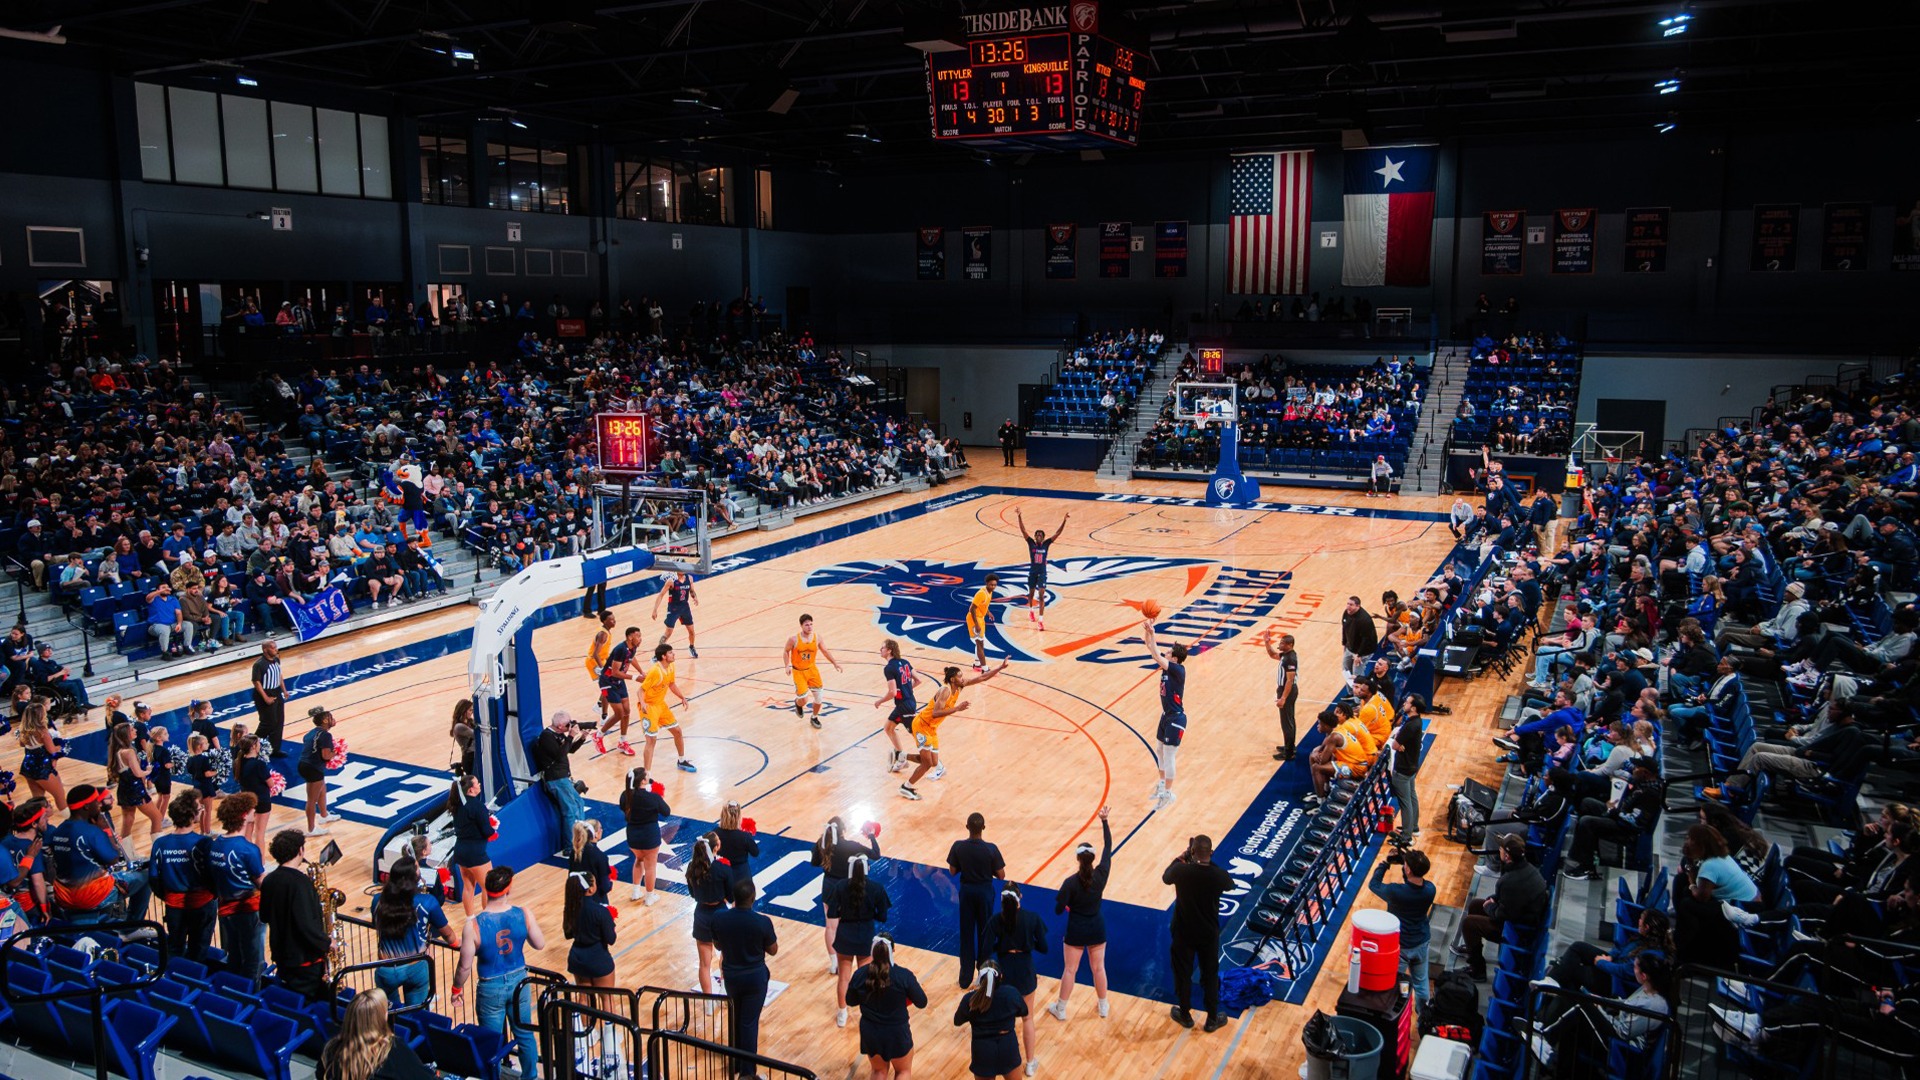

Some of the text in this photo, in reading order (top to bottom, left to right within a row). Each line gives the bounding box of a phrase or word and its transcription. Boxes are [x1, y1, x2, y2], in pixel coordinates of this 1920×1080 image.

[981, 41, 1024, 63] 13:26
[1024, 61, 1069, 74] KINGSVILLE
[990, 71, 1010, 79] PERIOD
[1001, 82, 1006, 95] 1
[1046, 74, 1063, 94] 13
[1074, 35, 1091, 130] PATRIOTS
[953, 81, 969, 101] 13
[983, 100, 1003, 108] PLAYER
[1047, 96, 1065, 104] FOULS
[953, 104, 1064, 125] 1 4 30 1 3 1
[279, 217, 285, 228] 3
[1326, 238, 1332, 246] 7
[1203, 351, 1220, 359] 13:26
[608, 420, 641, 436] 13:26
[619, 439, 637, 464] 11
[899, 664, 912, 685] 24
